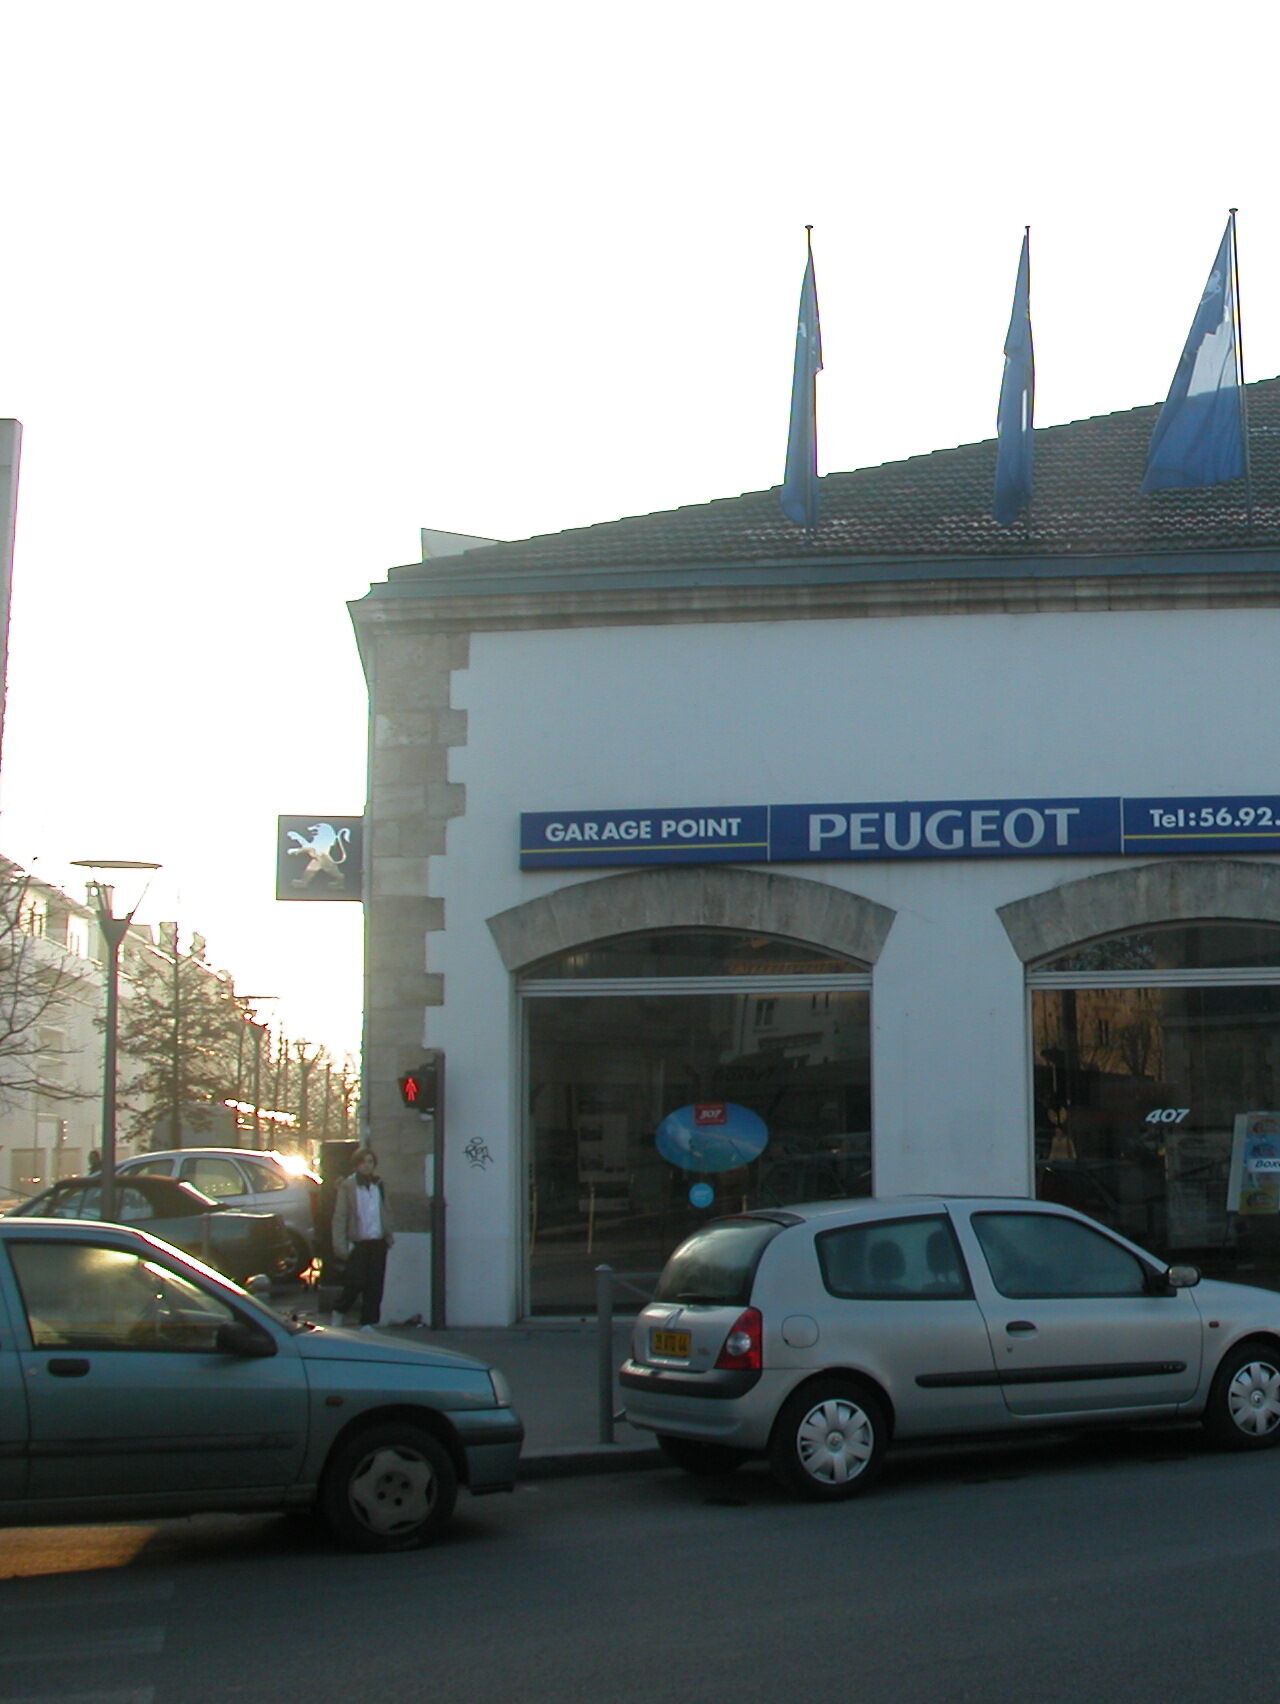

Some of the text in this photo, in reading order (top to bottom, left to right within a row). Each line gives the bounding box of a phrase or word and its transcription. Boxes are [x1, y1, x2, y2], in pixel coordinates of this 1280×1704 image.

[545, 817, 742, 841] GARAGE POINT
[808, 807, 1080, 852] PEUGEOT
[1145, 1108, 1190, 1123] 407
